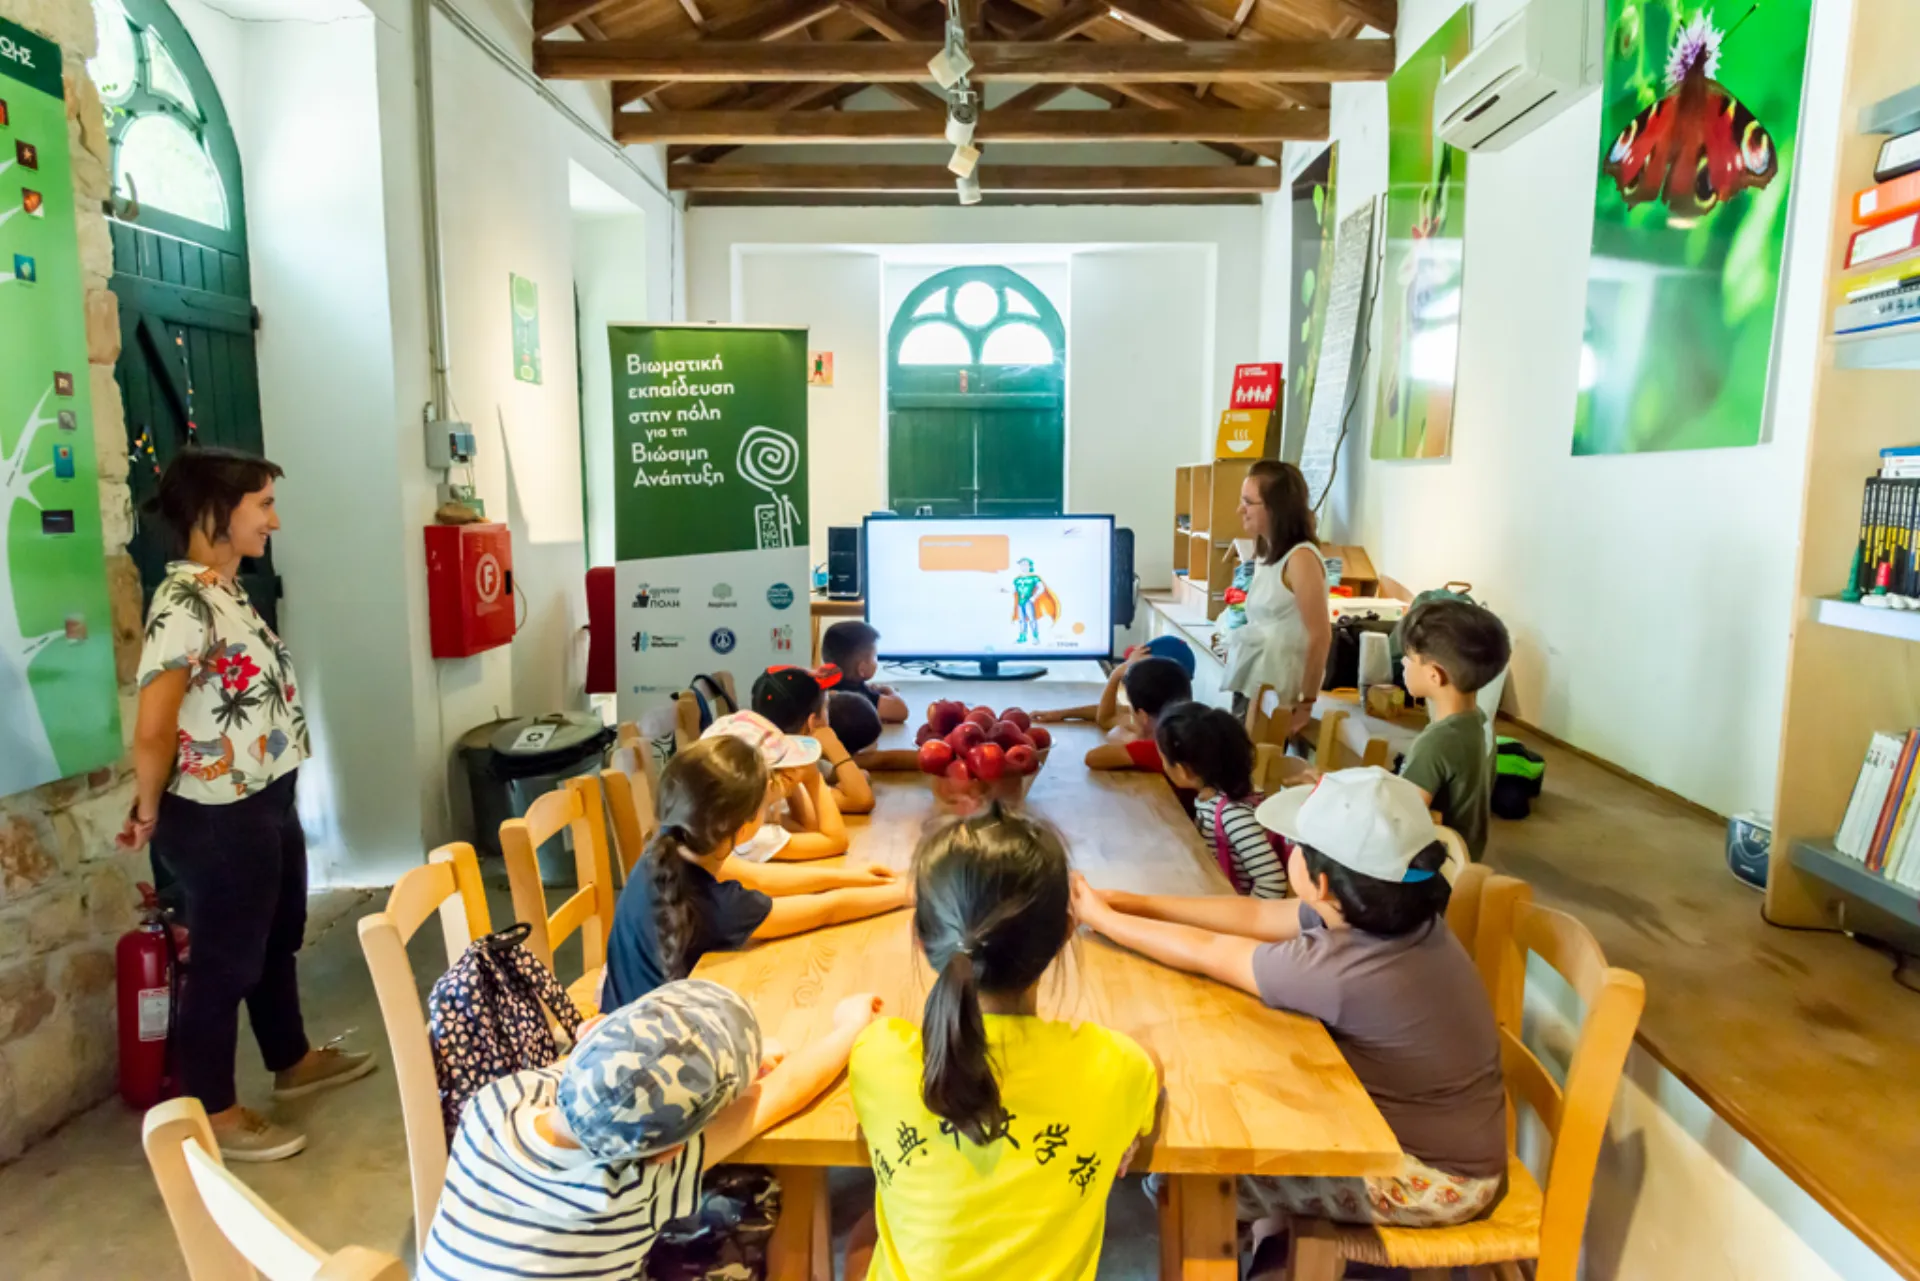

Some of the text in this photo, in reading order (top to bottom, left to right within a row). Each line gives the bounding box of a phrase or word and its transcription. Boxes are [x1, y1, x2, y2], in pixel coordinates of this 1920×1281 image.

[626, 354, 723, 378] Βιωματική
[628, 376, 735, 399] εκπαίδευση
[629, 399, 721, 424] στην πόλη
[645, 427, 687, 442] για τη
[631, 442, 709, 466] Βιώσιμη
[633, 463, 724, 487] Ανάπτυξη
[484, 564, 494, 593] F
